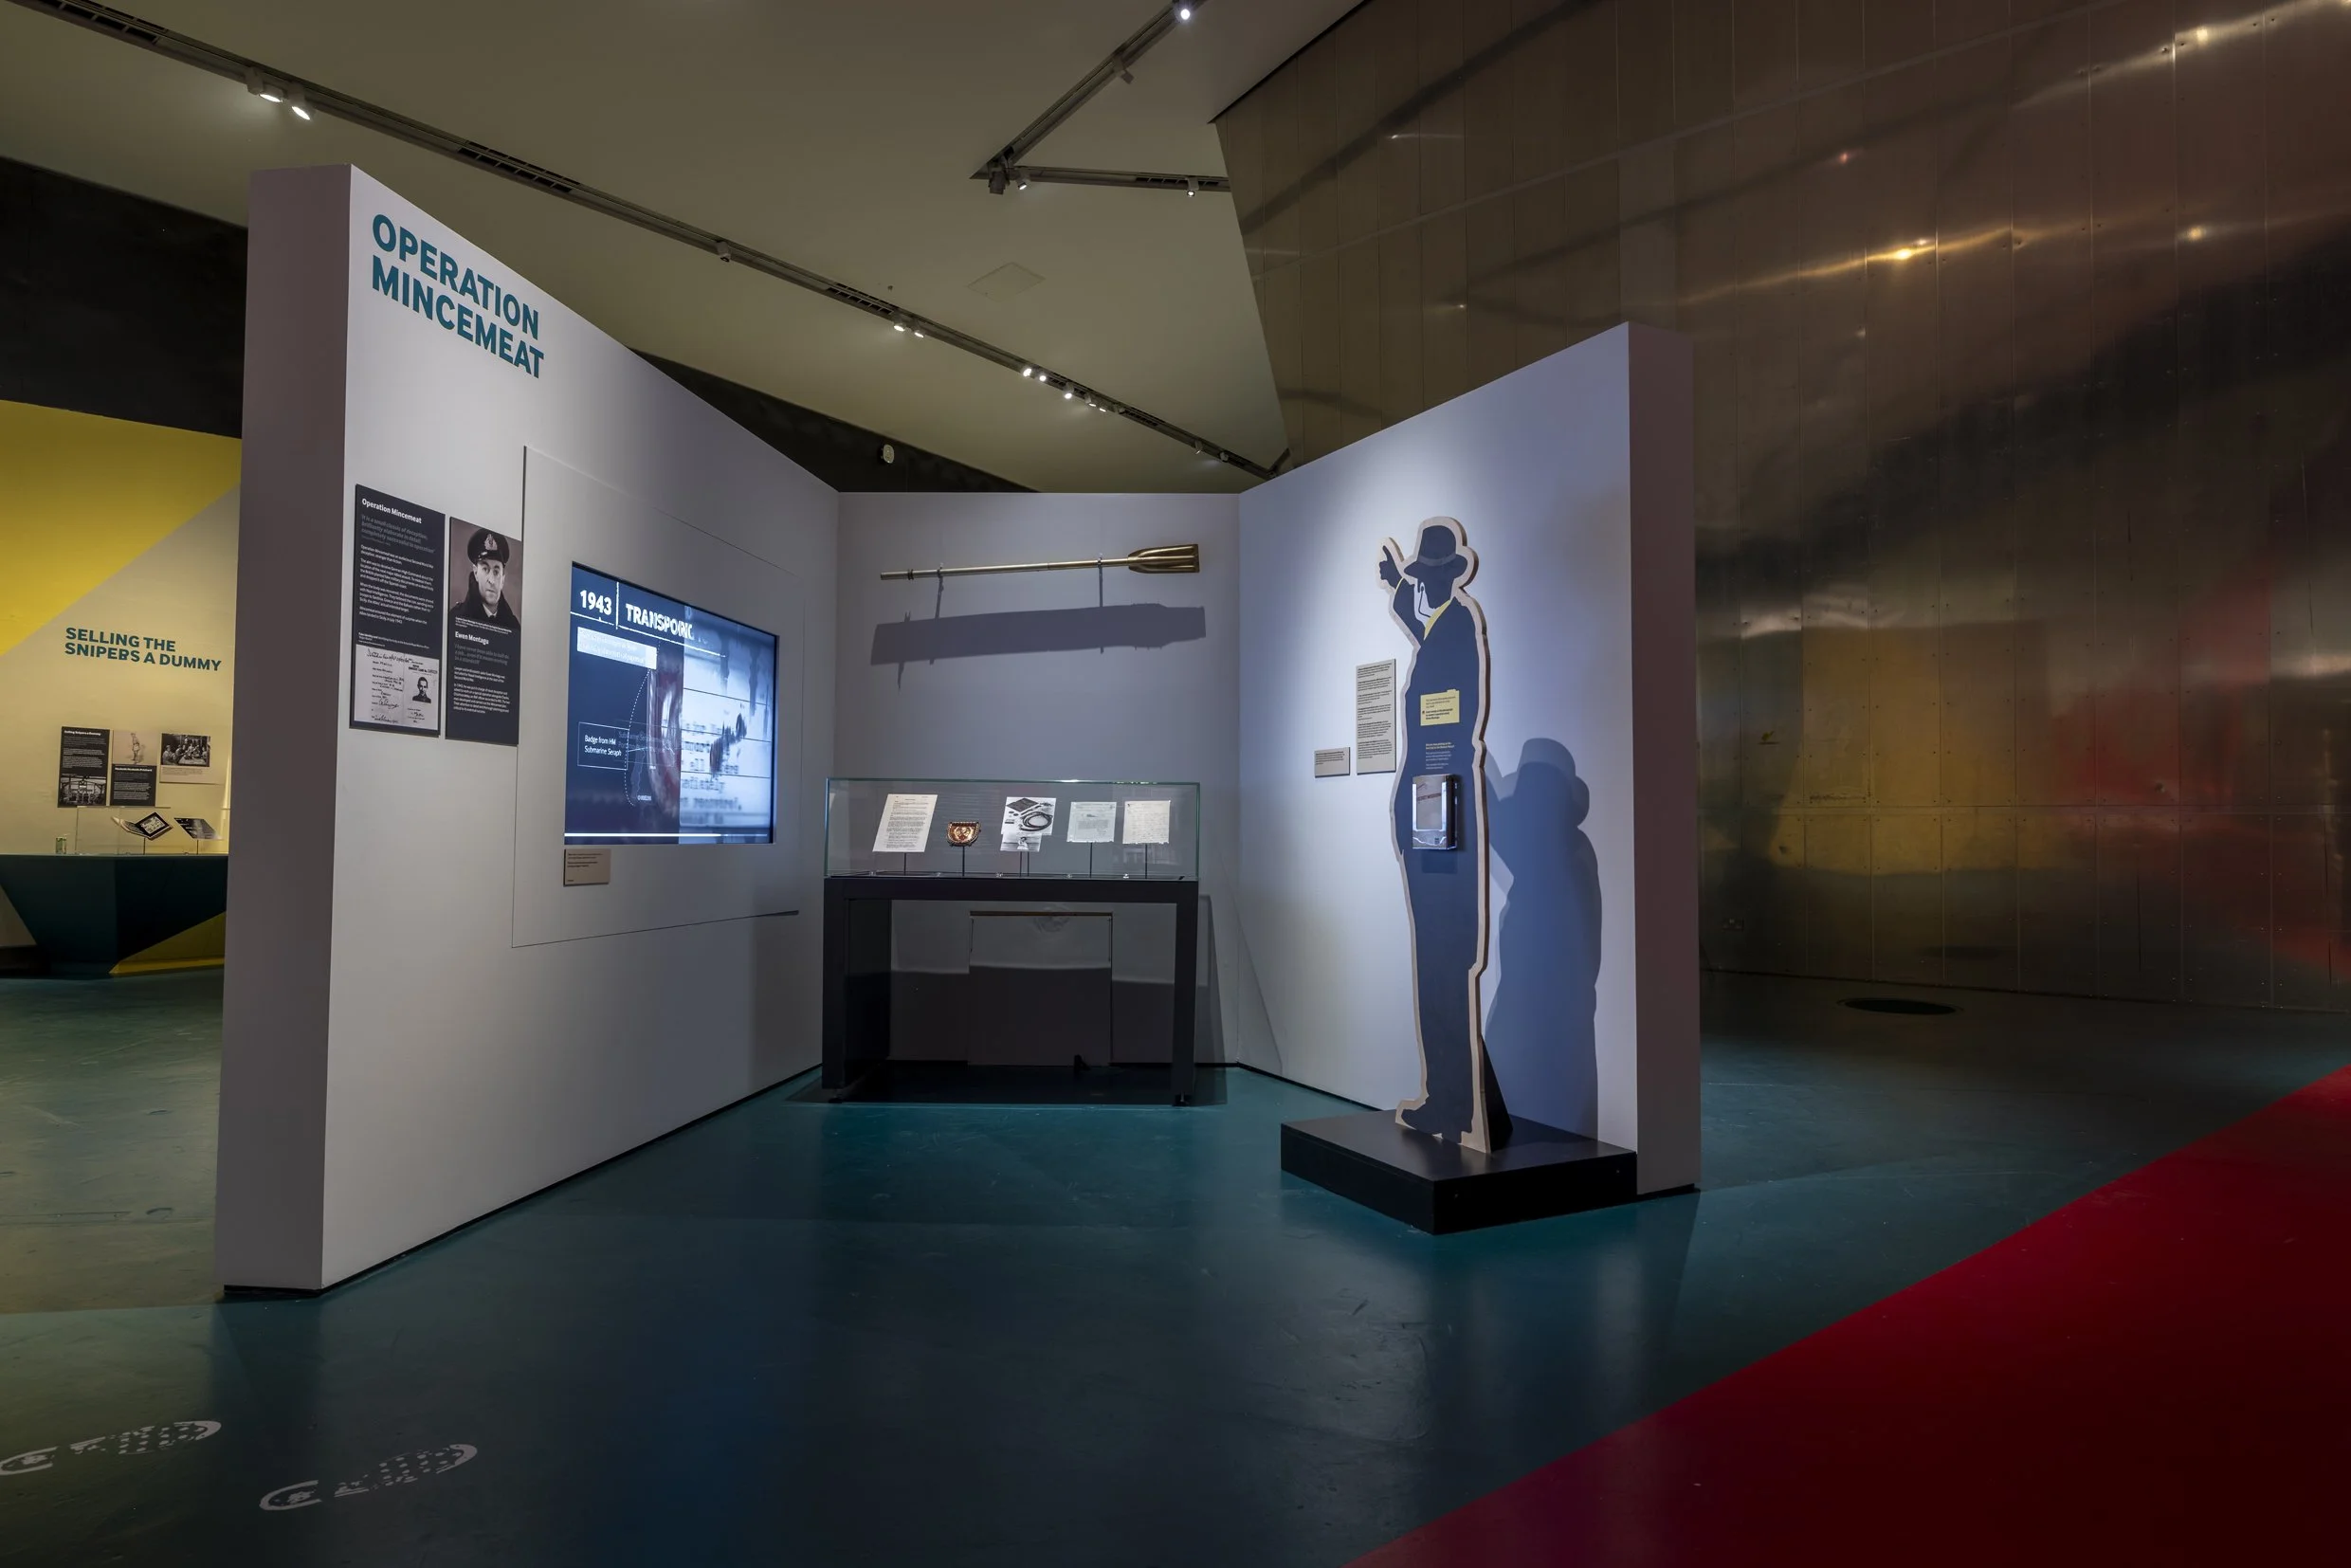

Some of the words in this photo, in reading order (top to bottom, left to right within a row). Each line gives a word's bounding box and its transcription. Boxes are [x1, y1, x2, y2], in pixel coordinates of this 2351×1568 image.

[373, 214, 538, 340] OPERATION
[373, 254, 544, 379] MINCEMEAT
[361, 498, 391, 514] Operation
[391, 507, 422, 524] Mincemeat
[580, 590, 611, 615] 1943
[65, 627, 140, 648] SELLING
[143, 636, 176, 652] THE
[455, 630, 468, 640] Ewen
[468, 633, 489, 646] Montagu
[143, 652, 155, 665] A
[159, 653, 222, 671] DUMMY
[584, 735, 598, 745] Badge
[598, 736, 609, 744] from
[584, 745, 607, 756] Submarine
[607, 748, 622, 757] Seraph
